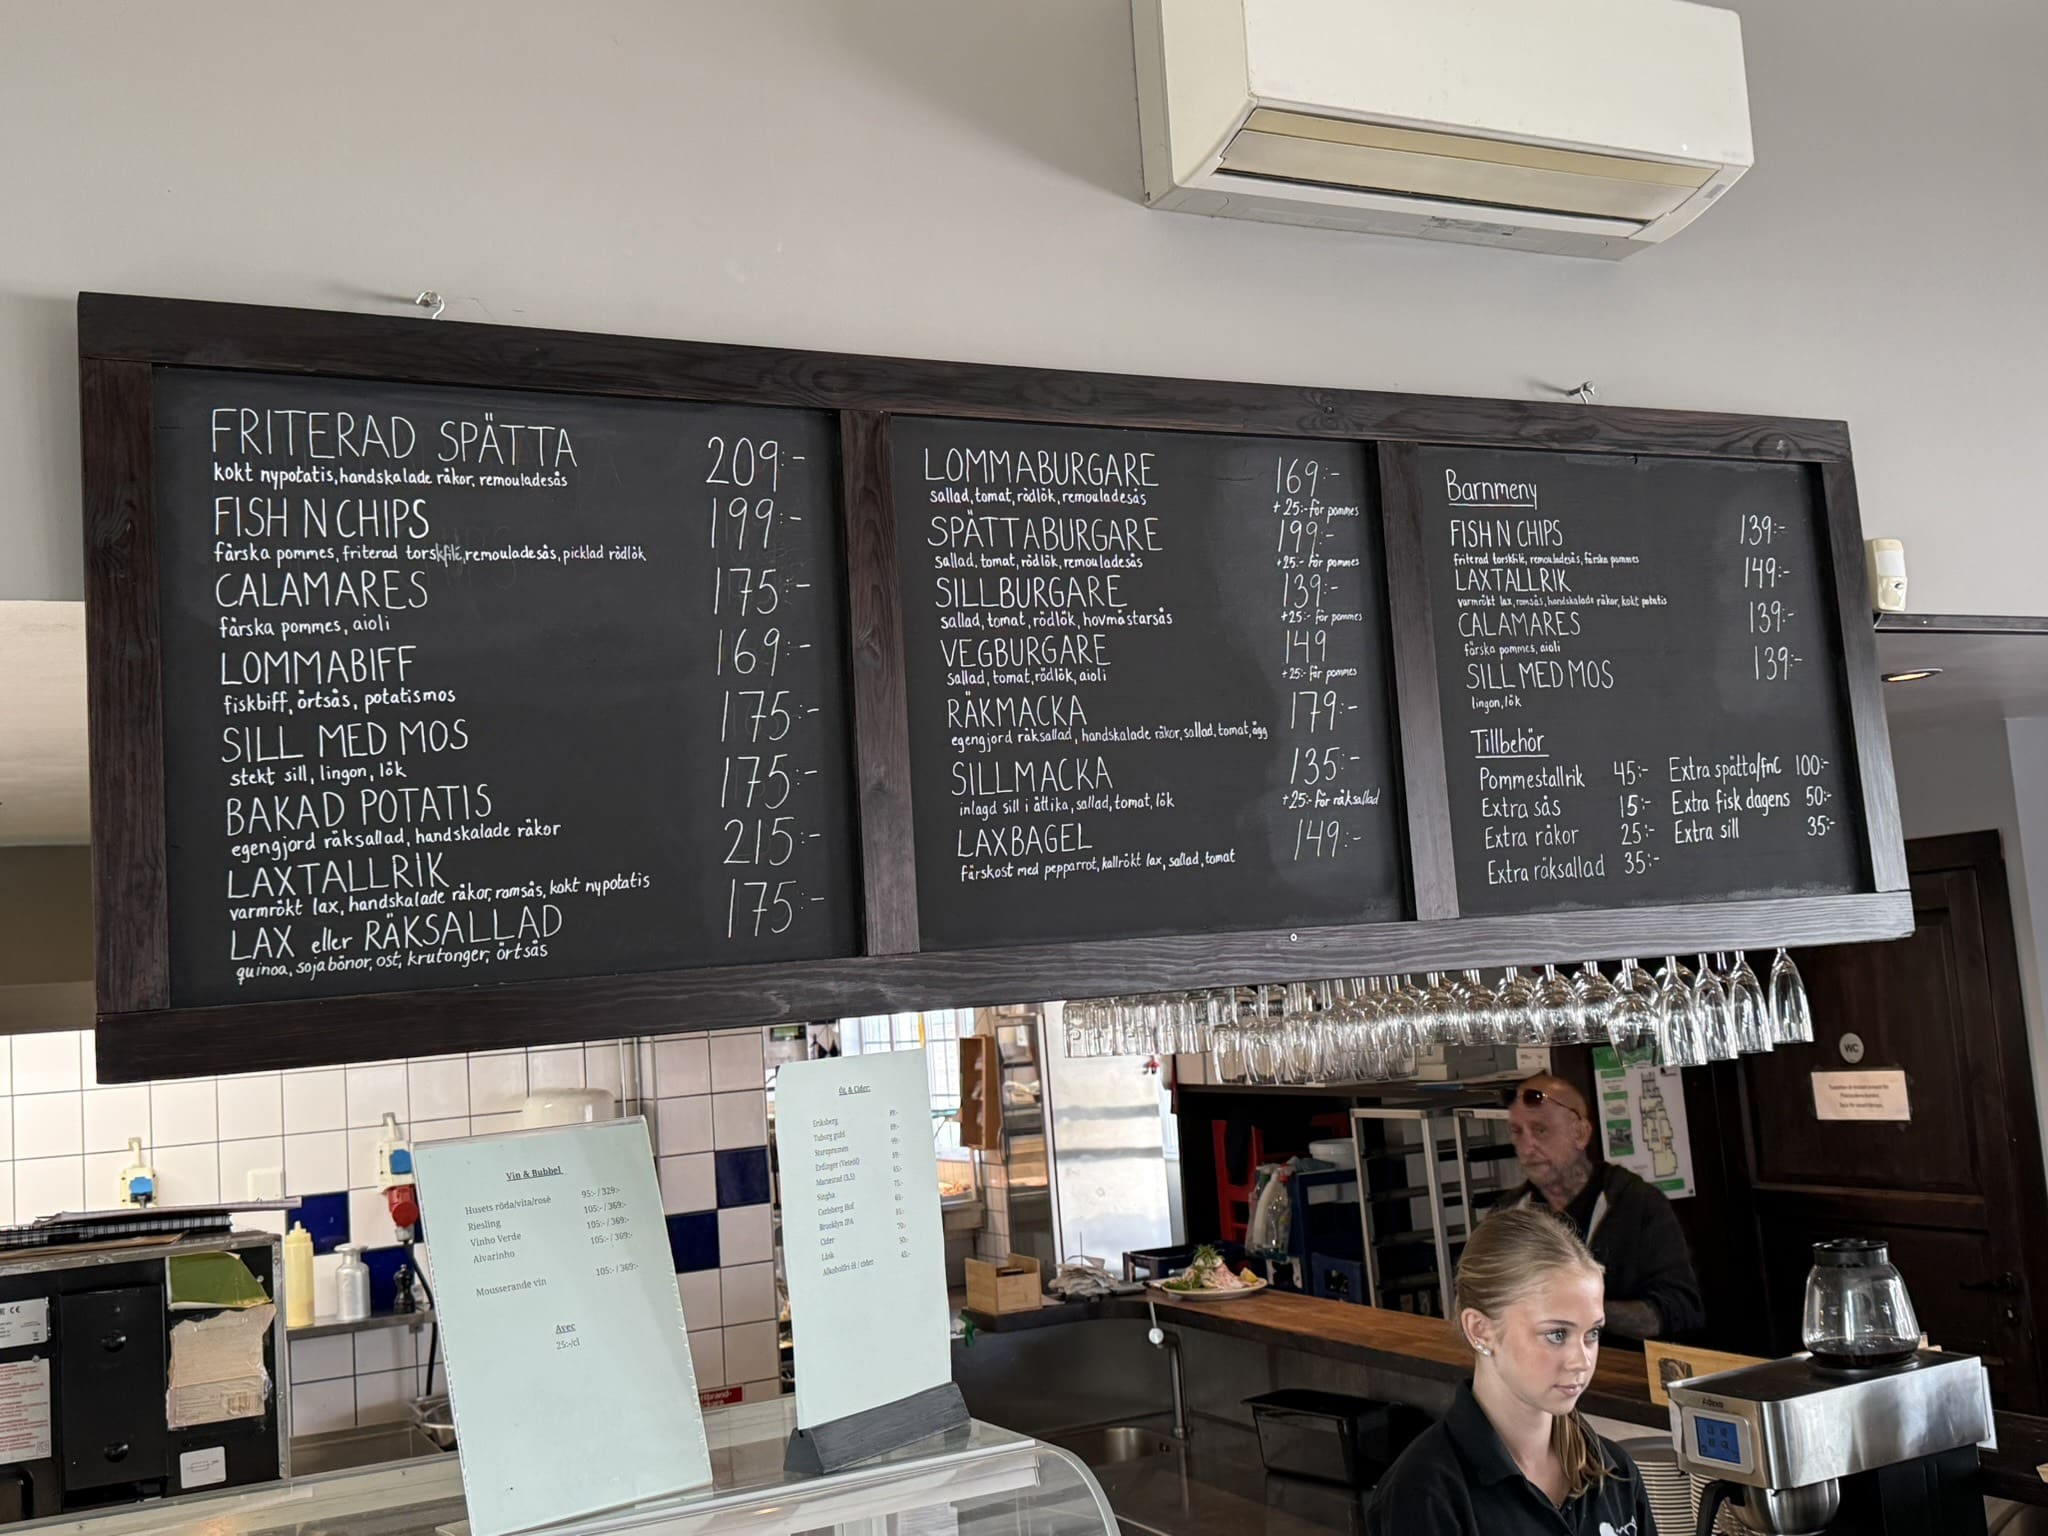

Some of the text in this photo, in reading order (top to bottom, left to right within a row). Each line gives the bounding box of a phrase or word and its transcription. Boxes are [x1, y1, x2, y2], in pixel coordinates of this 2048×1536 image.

[212, 408, 805, 492] FRITERAD SPÄTTA 209:-
[214, 462, 253, 482] kokt
[480, 471, 568, 487] remouladesås
[925, 448, 1340, 497] LOMMABURGARE 169:-
[930, 487, 1015, 506] sallad, tomat,
[1446, 469, 1537, 510] Barnmeny
[215, 497, 801, 550] FISH N CHIPS 199:-
[928, 509, 1334, 557] SPÄTTABURGARE 199:-
[1451, 514, 1785, 547] FISH N CHIPS 139:-
[277, 544, 604, 568] pommes, friterad picklad
[980, 553, 1019, 570] tomat,
[1455, 557, 1790, 592] LAXTALLRIK 149:-
[216, 567, 810, 616] CALAMARES 175:-
[936, 573, 1338, 608] SILLBURGARE 139:-
[281, 614, 390, 641] pommes, aioli
[941, 611, 1031, 630] sallad, tomat,
[1331, 613, 1362, 626] pommes
[1458, 601, 1794, 637] CALAMARES 139:-
[221, 628, 811, 685] LOMMABIFF 169:-
[940, 634, 1111, 667] VEGBURGARE
[1499, 640, 1560, 660] pommes, aioli
[947, 667, 1106, 687] sallad, tomat, aioli
[1467, 646, 1802, 689] SILL MED MOS 139:-
[224, 687, 456, 715] fiskbiff, potatismos
[948, 690, 1357, 733] RÄKMACKA 179:-
[1472, 696, 1503, 714] lingon,
[221, 691, 819, 763] SILL MED MOS 175:-
[952, 726, 1151, 753] egengjord handskalade
[1470, 728, 1544, 754] Tillbehör
[230, 764, 374, 786] stekt sill, lingon,
[1291, 747, 1360, 785] 135:-
[1480, 761, 1648, 791] Pommestallrik 45:-
[1669, 755, 1829, 782] Extra 100:-
[227, 754, 817, 836] BAKAD POTATIS 175:-
[960, 800, 997, 821] inlagd
[1003, 798, 1019, 814] sill
[1025, 803, 1028, 812] i
[1076, 794, 1112, 812] sallad,
[1482, 795, 1651, 818] Extra sås 15:-
[1672, 786, 1832, 816] Extra fisk dagens 50:-
[231, 832, 316, 863] egengjord
[415, 822, 511, 844] handskalade
[517, 818, 561, 837] räkor
[958, 819, 1361, 860] LAXBAGEL 149:-
[1485, 822, 1655, 849] Extra 25:-
[1675, 815, 1835, 844] Extra sill 35:-
[228, 817, 820, 903] LAXTALLRIK 215:-
[961, 848, 1235, 882] färskost med pepparrot, lax, sallad, tomat
[1488, 851, 1659, 884] Extra 35:-
[313, 872, 650, 916] lax, handskalade kokt nypotatis
[231, 879, 824, 960] LAX eller RÄKSALLAD 175:-
[236, 962, 292, 985] quinoa,
[1844, 1043, 1859, 1053] WC
[506, 1166, 562, 1180] Vin & Bubbel
[465, 1202, 494, 1215] Husets
[467, 1219, 502, 1232] Riesling
[470, 1235, 496, 1247] Vinho
[497, 1232, 522, 1244] Verde
[473, 1250, 515, 1264] Alvarinho
[476, 1280, 532, 1297] Mousserande
[533, 1277, 547, 1288] vin
[555, 1323, 576, 1334] Avec
